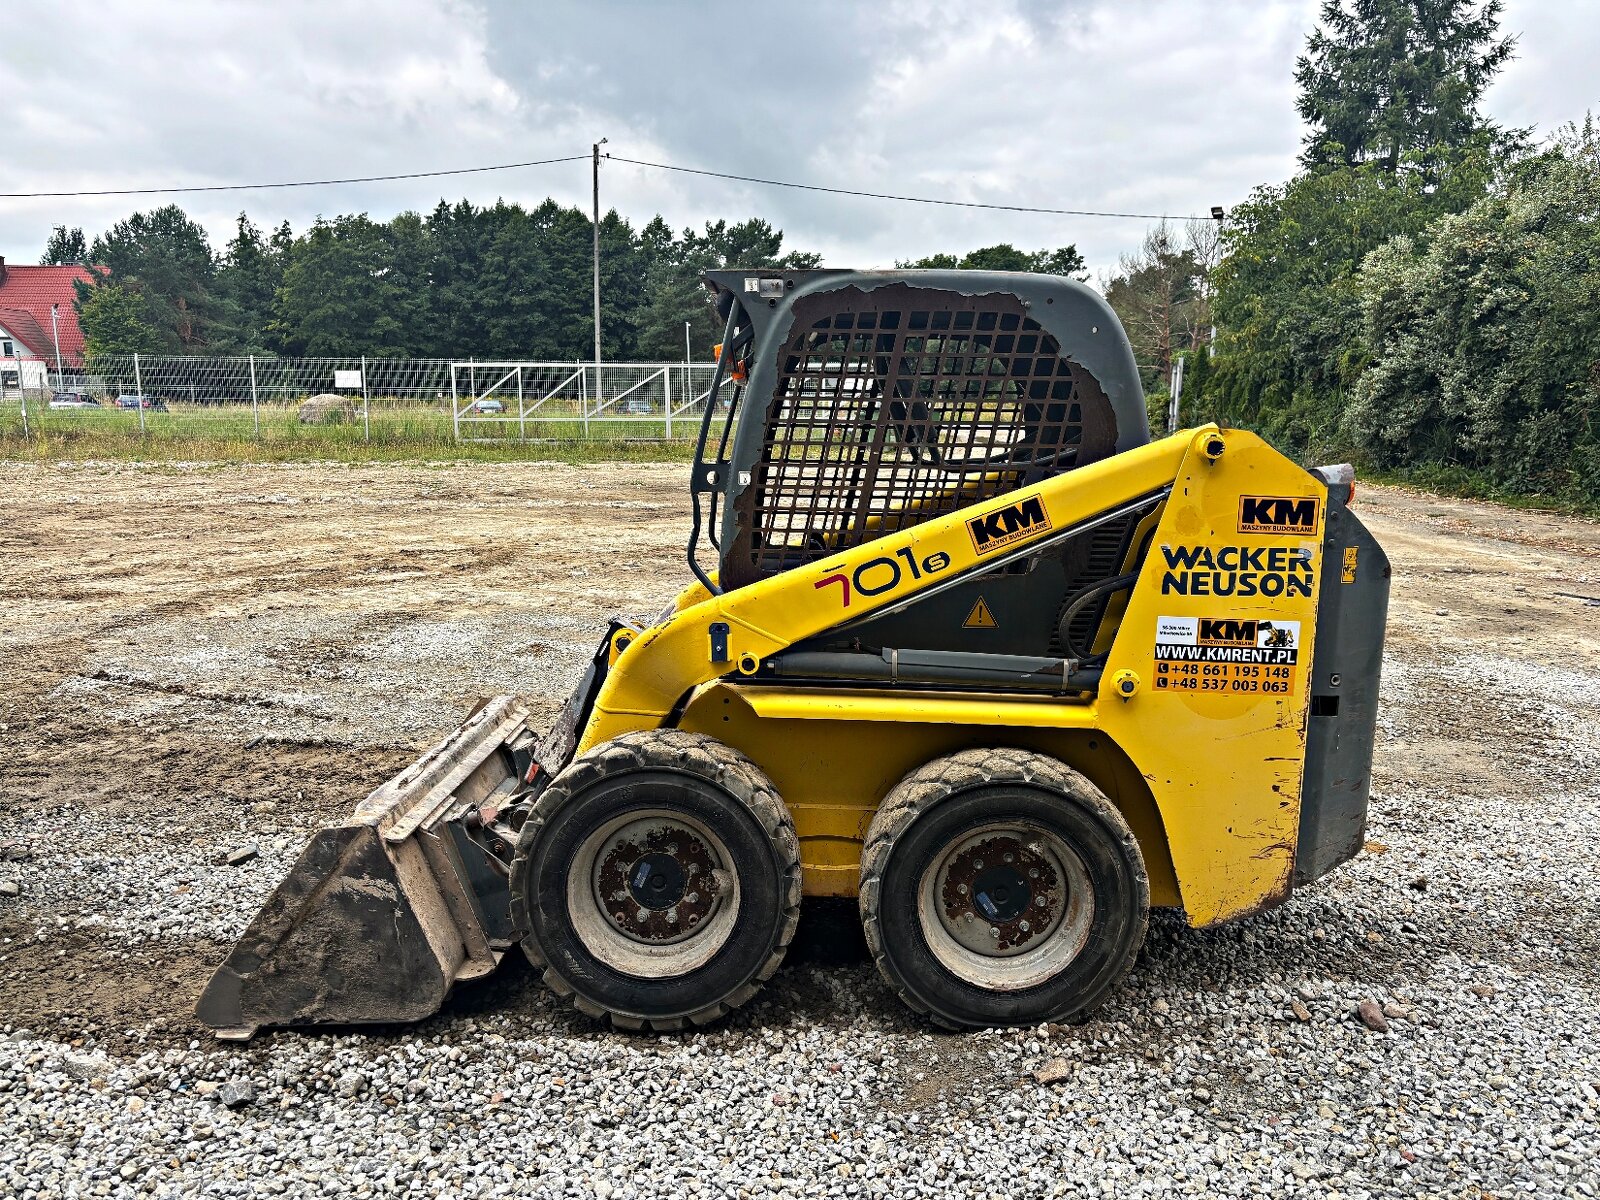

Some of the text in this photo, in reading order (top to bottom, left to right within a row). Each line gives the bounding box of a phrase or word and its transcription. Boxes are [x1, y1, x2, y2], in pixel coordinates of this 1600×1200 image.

[970, 498, 1046, 546] KM
[1242, 498, 1316, 526] KM
[978, 521, 1048, 552] MASZYNY BUDOWLANE
[1241, 524, 1313, 533] MASZYNY BUDOWLANE
[1160, 545, 1314, 572] WACKER
[1161, 571, 1314, 598] NEUSON
[1200, 620, 1257, 641] KM
[1155, 645, 1296, 664] WWW.KMRENT.PL
[1171, 663, 1290, 679] +48 661 195 148
[1170, 677, 1289, 693] +48 537 003 063
